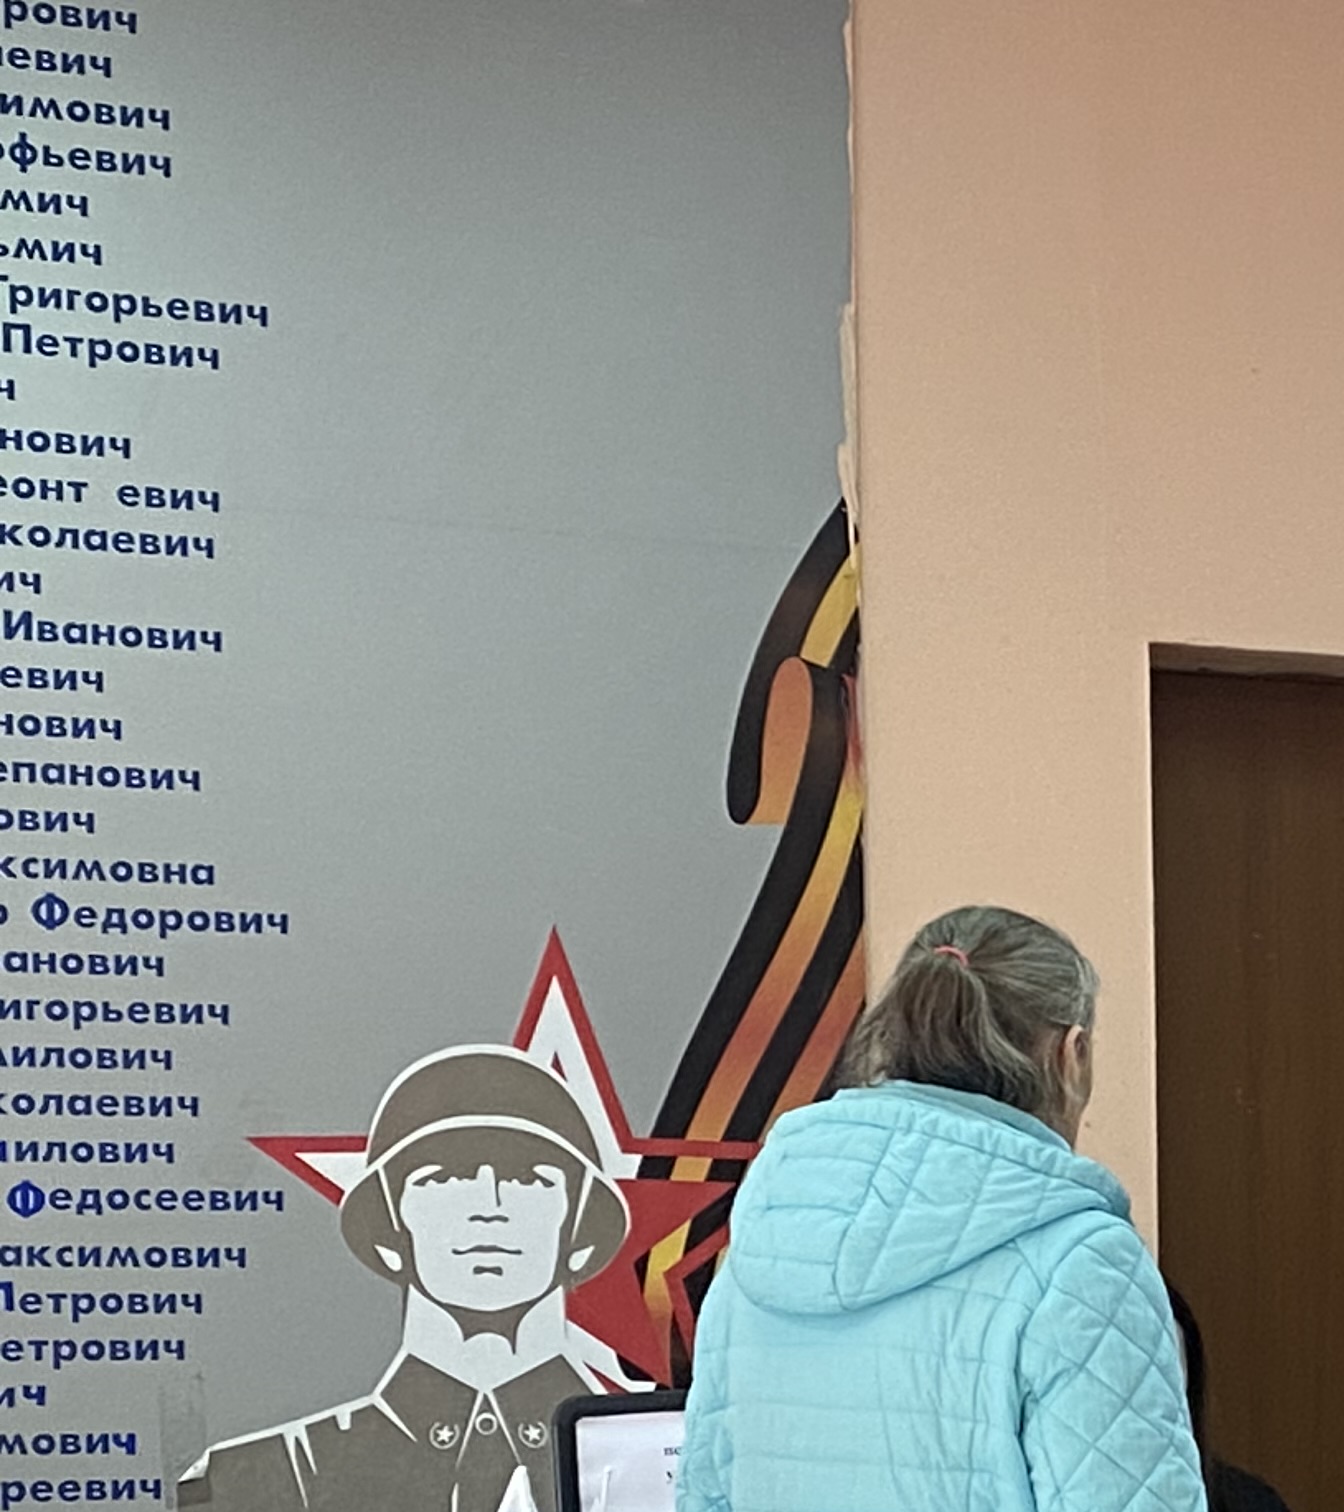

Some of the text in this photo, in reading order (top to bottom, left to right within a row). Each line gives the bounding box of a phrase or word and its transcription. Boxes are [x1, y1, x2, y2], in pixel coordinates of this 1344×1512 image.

[4, 0, 137, 34] рович
[0, 47, 111, 78] евич
[0, 93, 170, 131] имович
[0, 132, 171, 178] фьевич
[0, 190, 88, 217] мич
[3, 322, 219, 370] Петрович
[0, 428, 130, 459] нович
[117, 484, 219, 513] евич
[0, 524, 214, 559] колаевич
[4, 610, 222, 652] Иванович
[0, 666, 103, 693] евич
[31, 893, 288, 939] Федорович
[4, 952, 164, 977] анович
[0, 999, 229, 1030] игорьевич
[0, 1046, 172, 1070] илович
[0, 1141, 174, 1164] илович
[7, 1181, 283, 1218] Федосеевич
[0, 1246, 246, 1268] аксимович
[0, 1340, 185, 1370] етрович
[0, 1433, 136, 1455] мович
[1, 1479, 161, 1510] реевич
